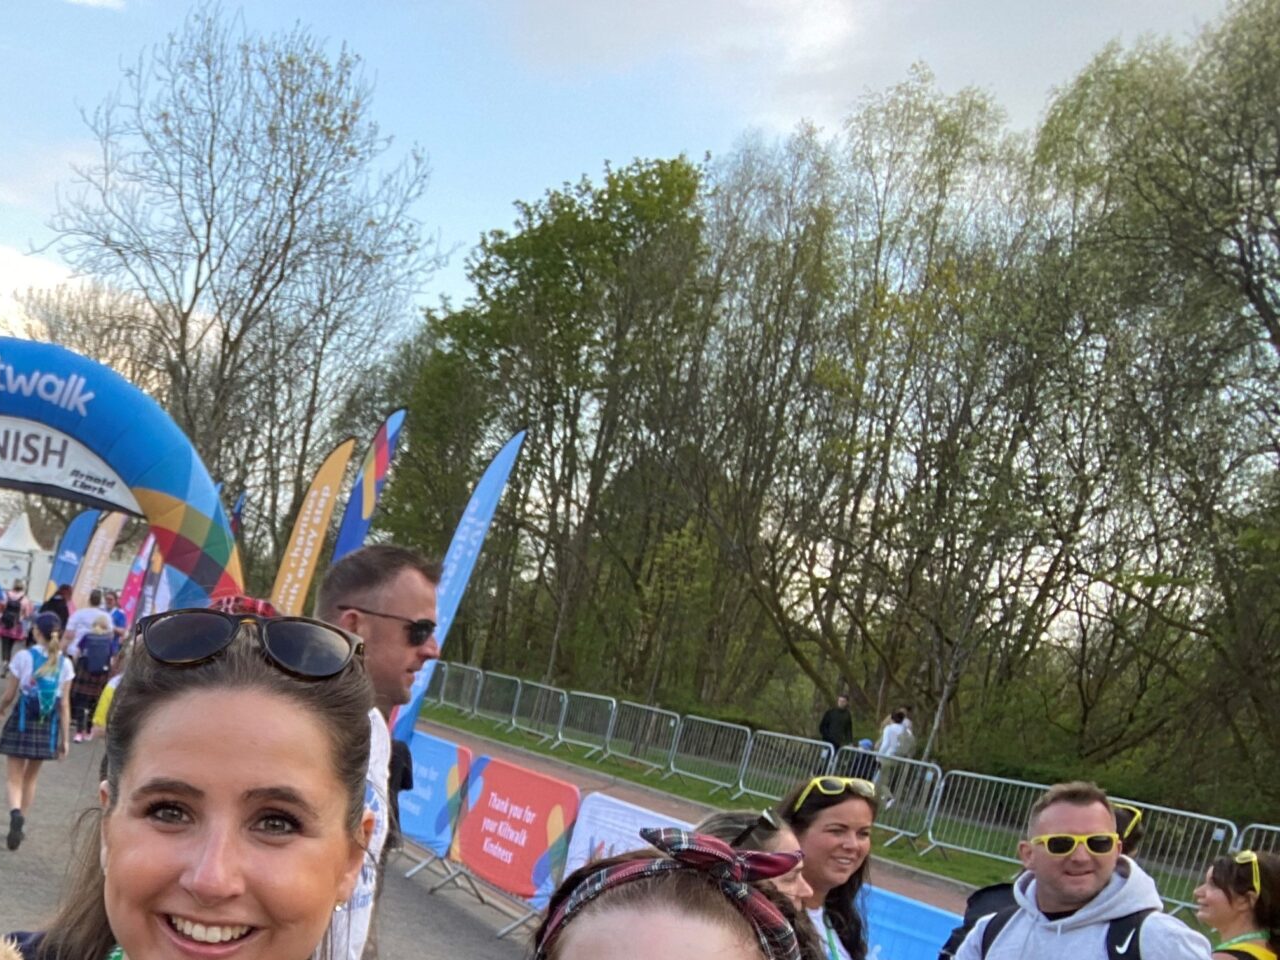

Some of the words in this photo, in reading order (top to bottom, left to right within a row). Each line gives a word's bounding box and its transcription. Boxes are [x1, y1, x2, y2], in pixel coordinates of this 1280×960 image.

[488, 791, 510, 814] Thank
[508, 803, 524, 820] you
[523, 805, 537, 824] for
[481, 817, 498, 833] your
[482, 837, 513, 865] Kindness
